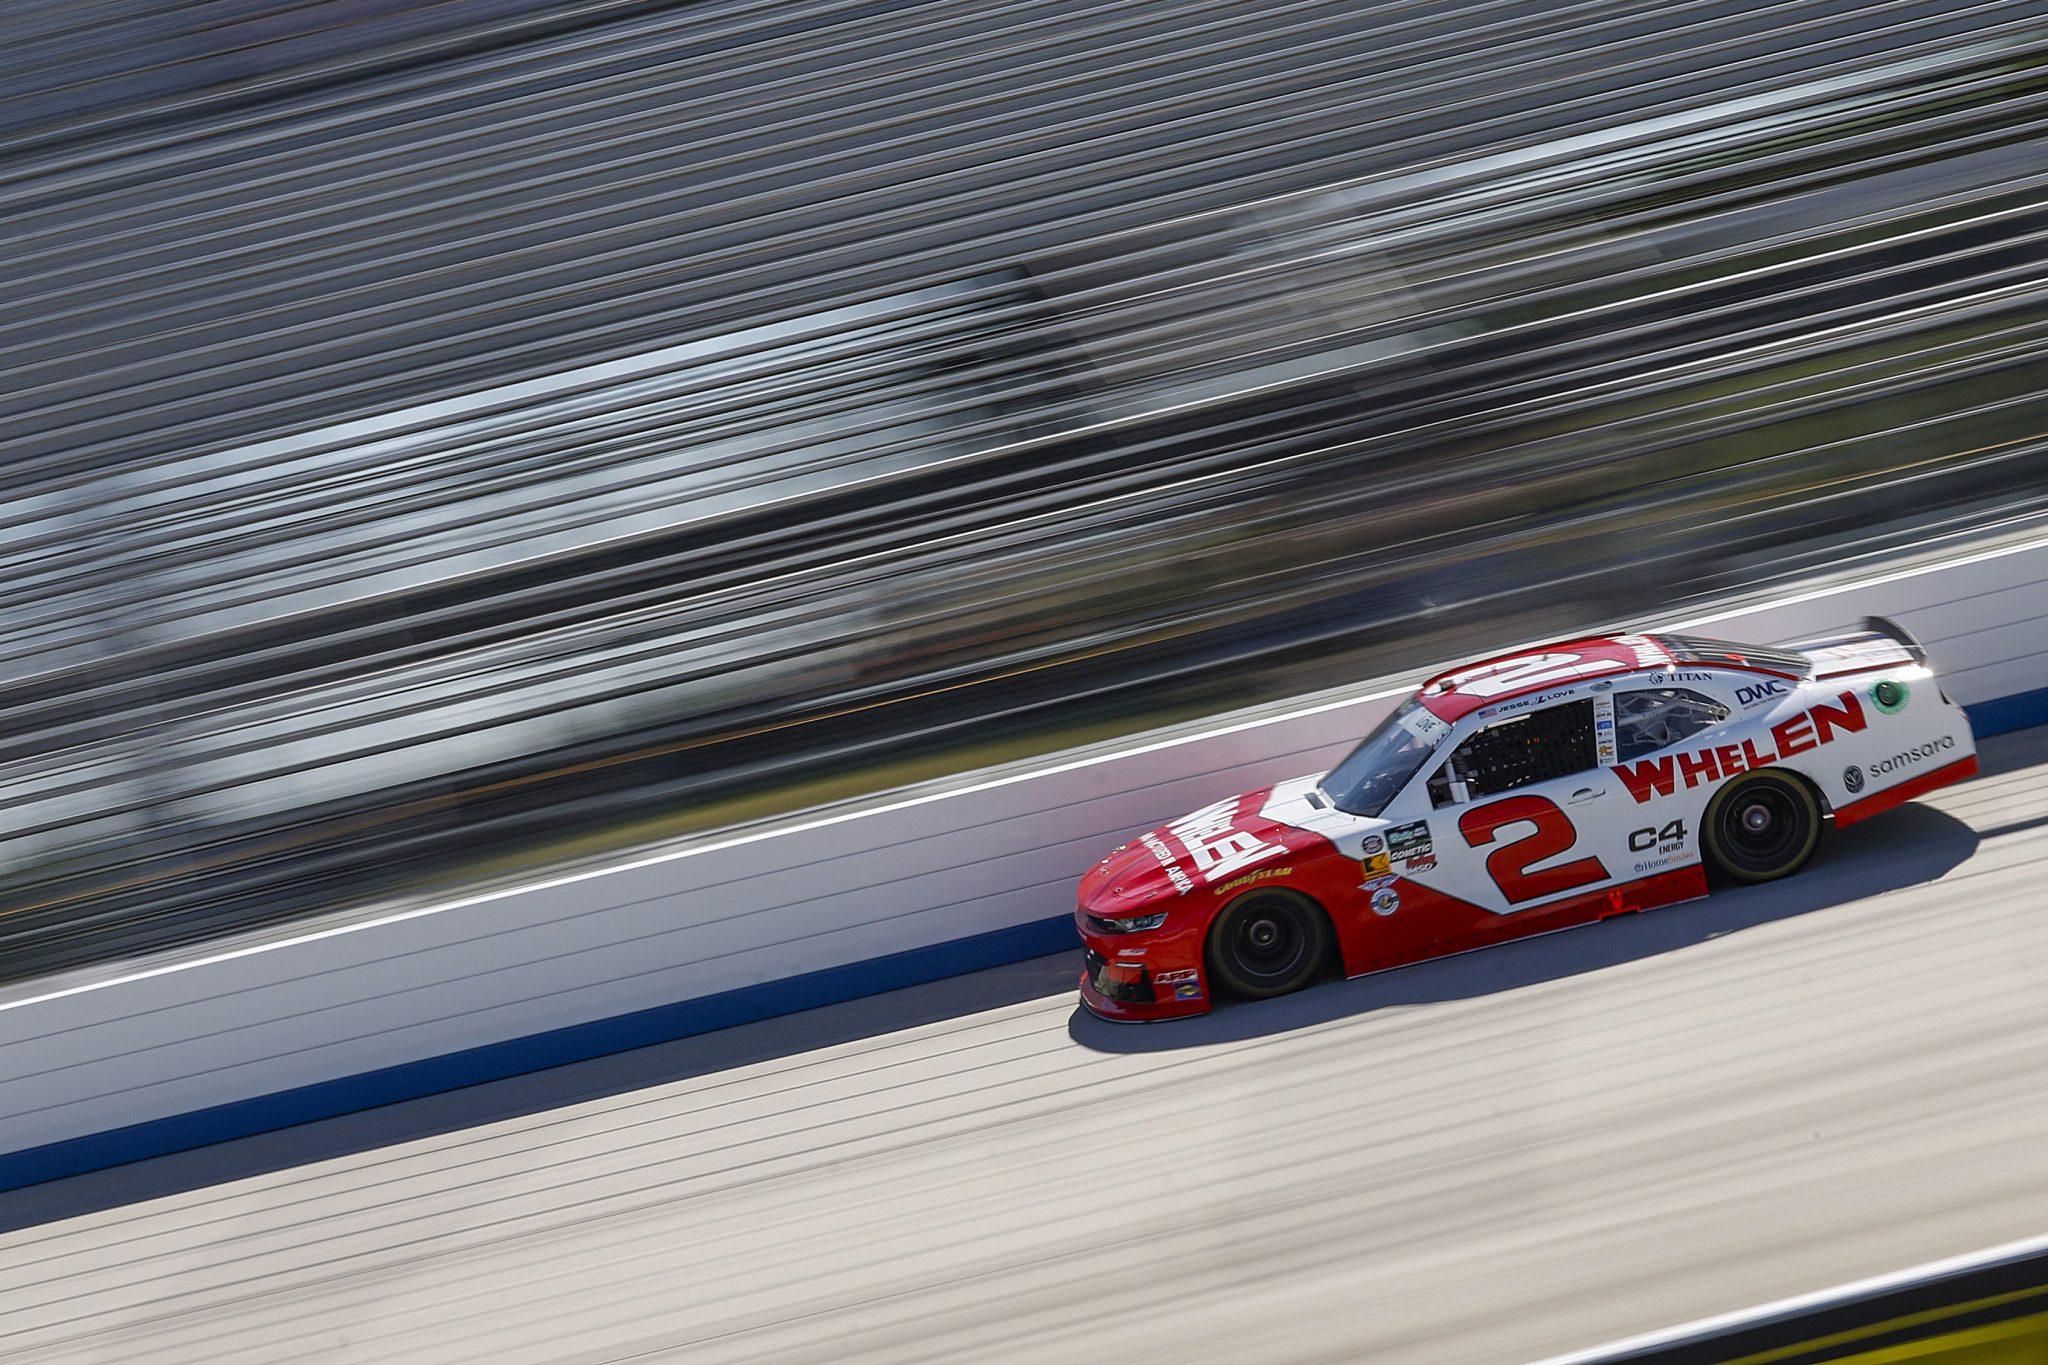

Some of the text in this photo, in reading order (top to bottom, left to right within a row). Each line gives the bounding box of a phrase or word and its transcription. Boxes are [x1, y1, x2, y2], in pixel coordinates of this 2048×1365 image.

[1668, 672, 1713, 682] TITAN
[1499, 700, 1530, 713] JESSE
[1547, 689, 1576, 700] LOVE
[1734, 679, 1787, 706] DWC
[1415, 716, 1436, 733] LOVE
[1610, 690, 1868, 804] WHELEN
[1870, 735, 1956, 778] samsara
[1165, 794, 1290, 882] WHELEN
[1628, 817, 1688, 852] C4
[1659, 841, 1685, 855] ENERGY
[1391, 842, 1432, 861] COMETIC
[1458, 794, 1612, 905] 2
[1644, 852, 1694, 871] HomeSmiles
[1214, 866, 1293, 896] GOODYEAR
